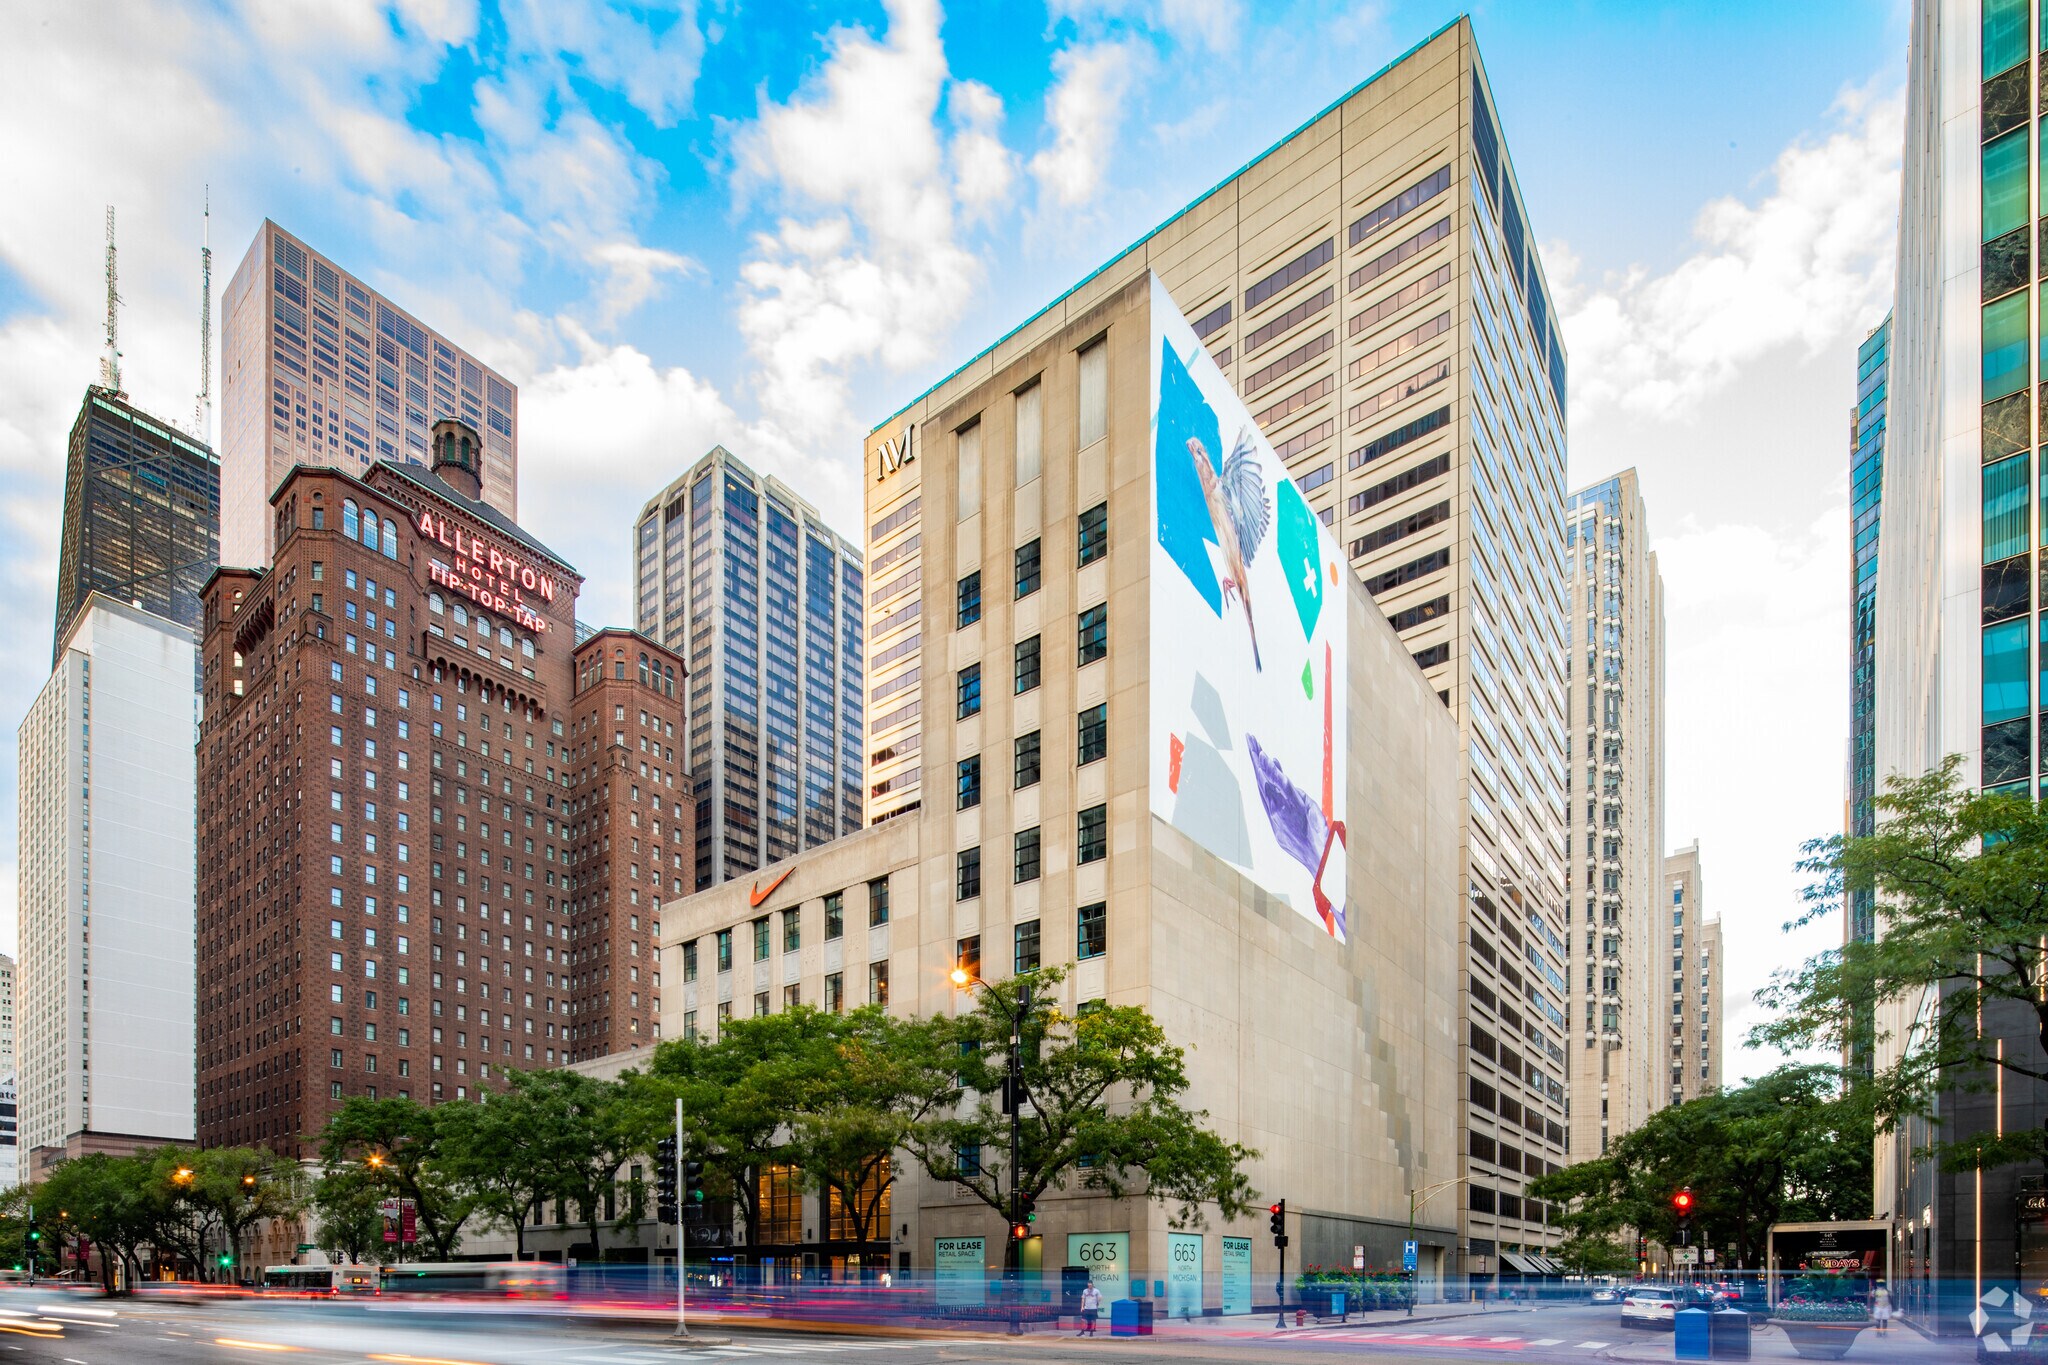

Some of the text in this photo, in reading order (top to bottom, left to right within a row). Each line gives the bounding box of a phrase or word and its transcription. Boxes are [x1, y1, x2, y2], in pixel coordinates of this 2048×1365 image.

[420, 512, 554, 602] ALLERTON
[456, 556, 523, 603] HOTEL
[938, 1241, 982, 1250] FOR LEASE
[1224, 1241, 1249, 1251] FOR LEASE
[1405, 1241, 1416, 1254] H
[1080, 1242, 1117, 1261] 663
[1174, 1243, 1196, 1262] 663
[1812, 1259, 1860, 1268] RIDAYS
[1089, 1273, 1119, 1282] HIGAN
[1173, 1273, 1197, 1282] MICHIGAN
